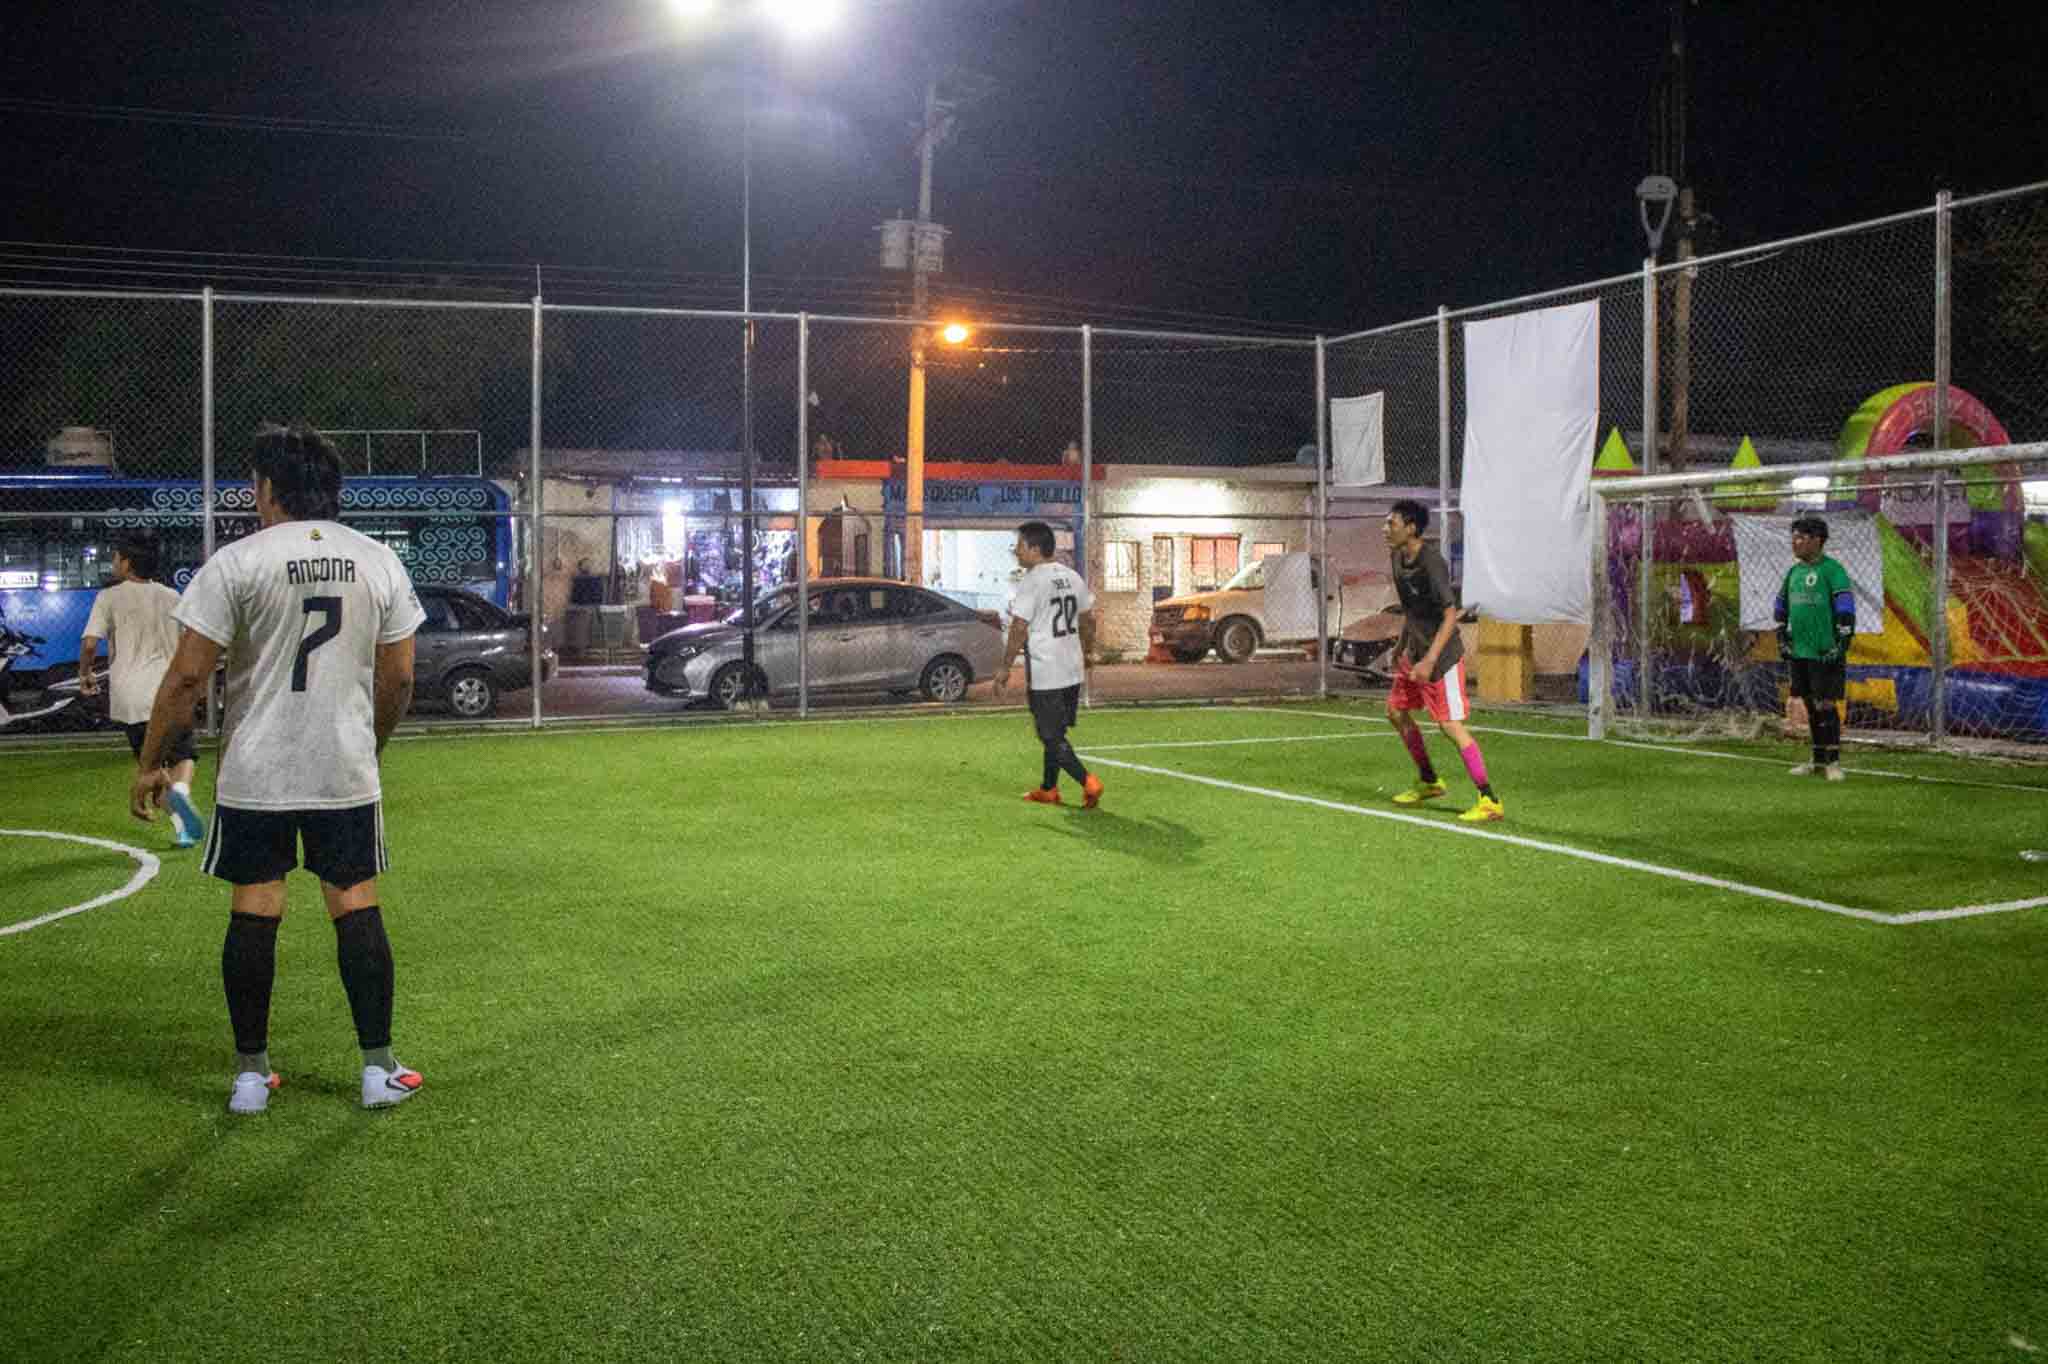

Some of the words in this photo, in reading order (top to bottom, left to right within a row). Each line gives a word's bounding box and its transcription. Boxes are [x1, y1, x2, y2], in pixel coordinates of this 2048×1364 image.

[889, 486, 980, 503] MAQUERIA
[1001, 486, 1024, 503] LOS
[287, 557, 356, 585] ANCONA
[1050, 594, 1078, 638] 20
[291, 595, 343, 692] 7
